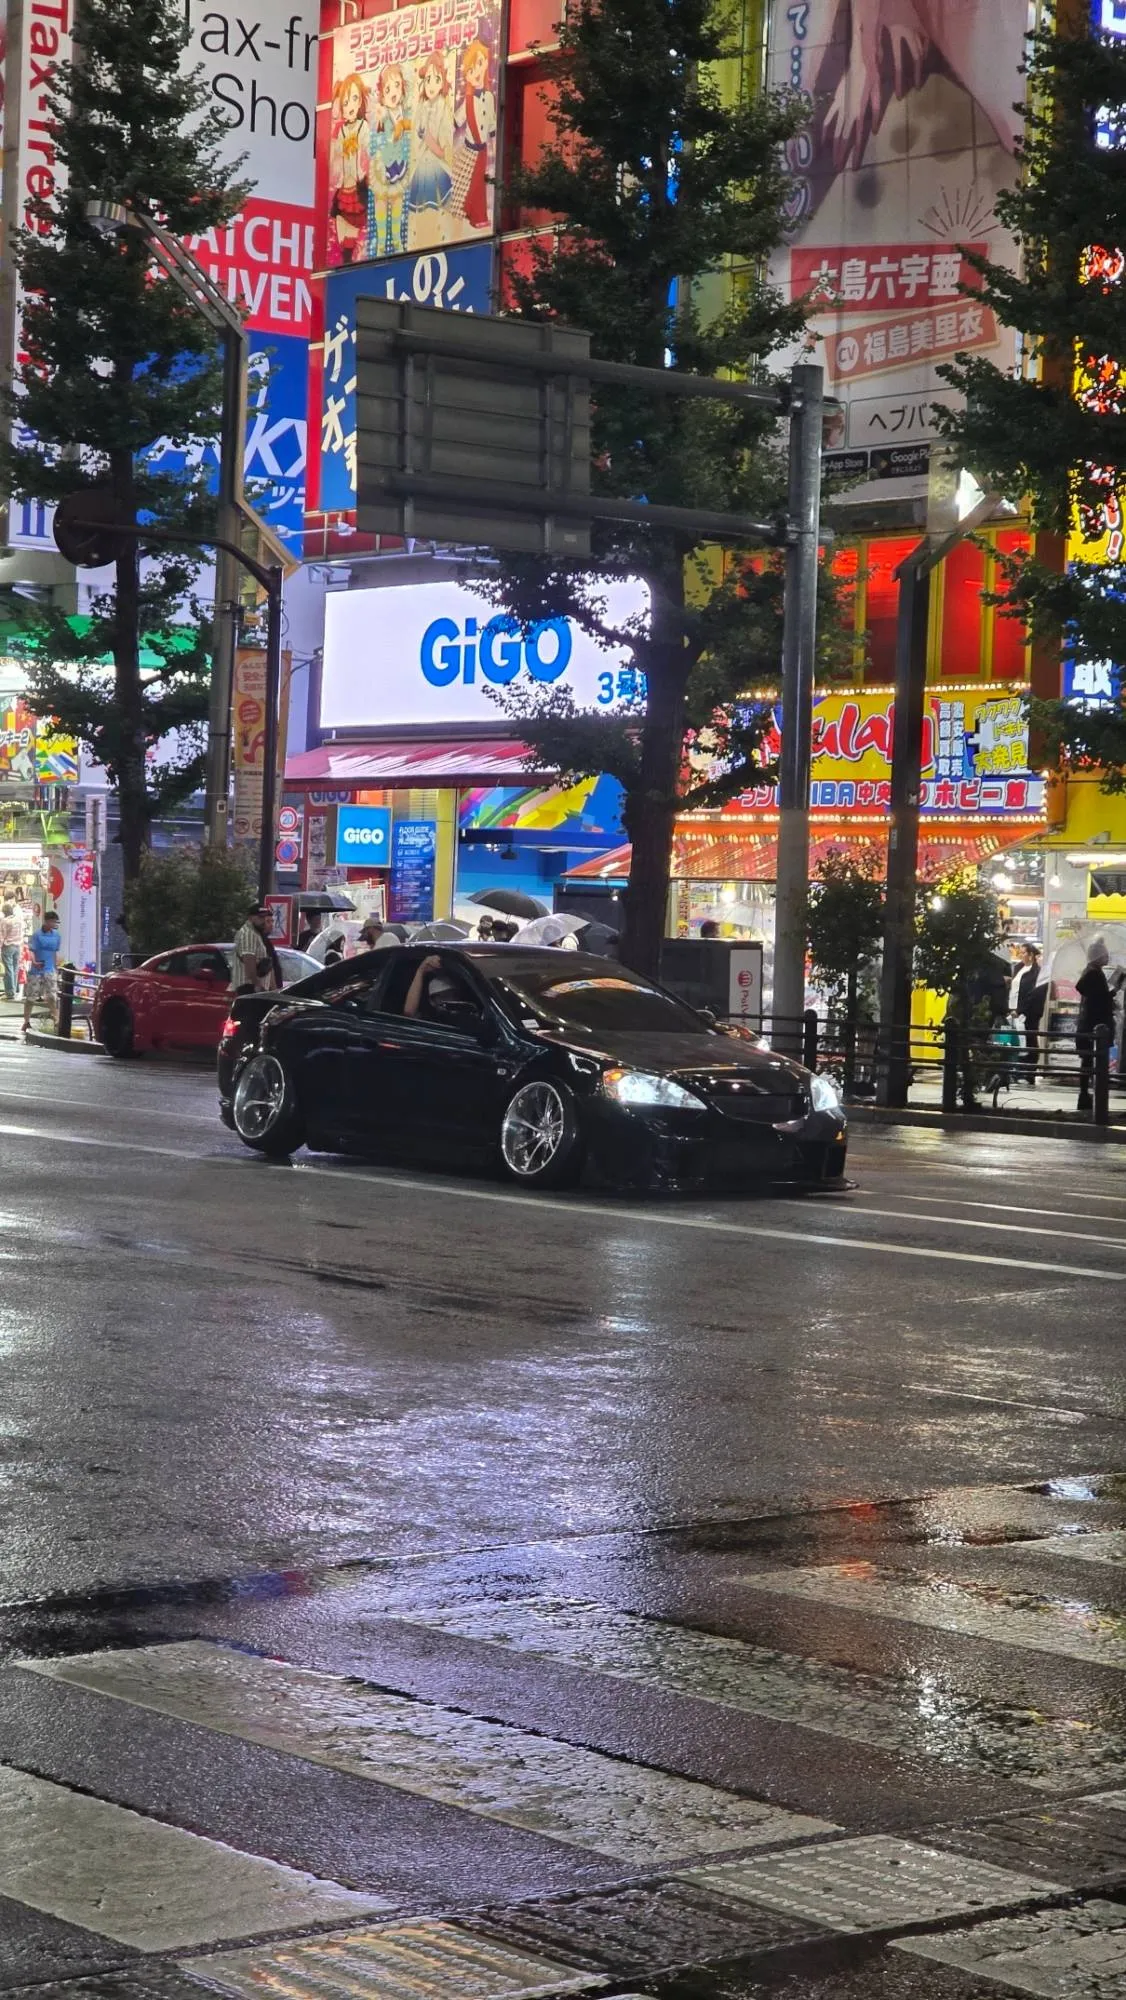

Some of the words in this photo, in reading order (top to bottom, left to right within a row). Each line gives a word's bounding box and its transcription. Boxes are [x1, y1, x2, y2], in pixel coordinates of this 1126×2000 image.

[211, 72, 318, 158] Sho
[420, 613, 573, 688] GiGO
[343, 827, 385, 845] GiGO
